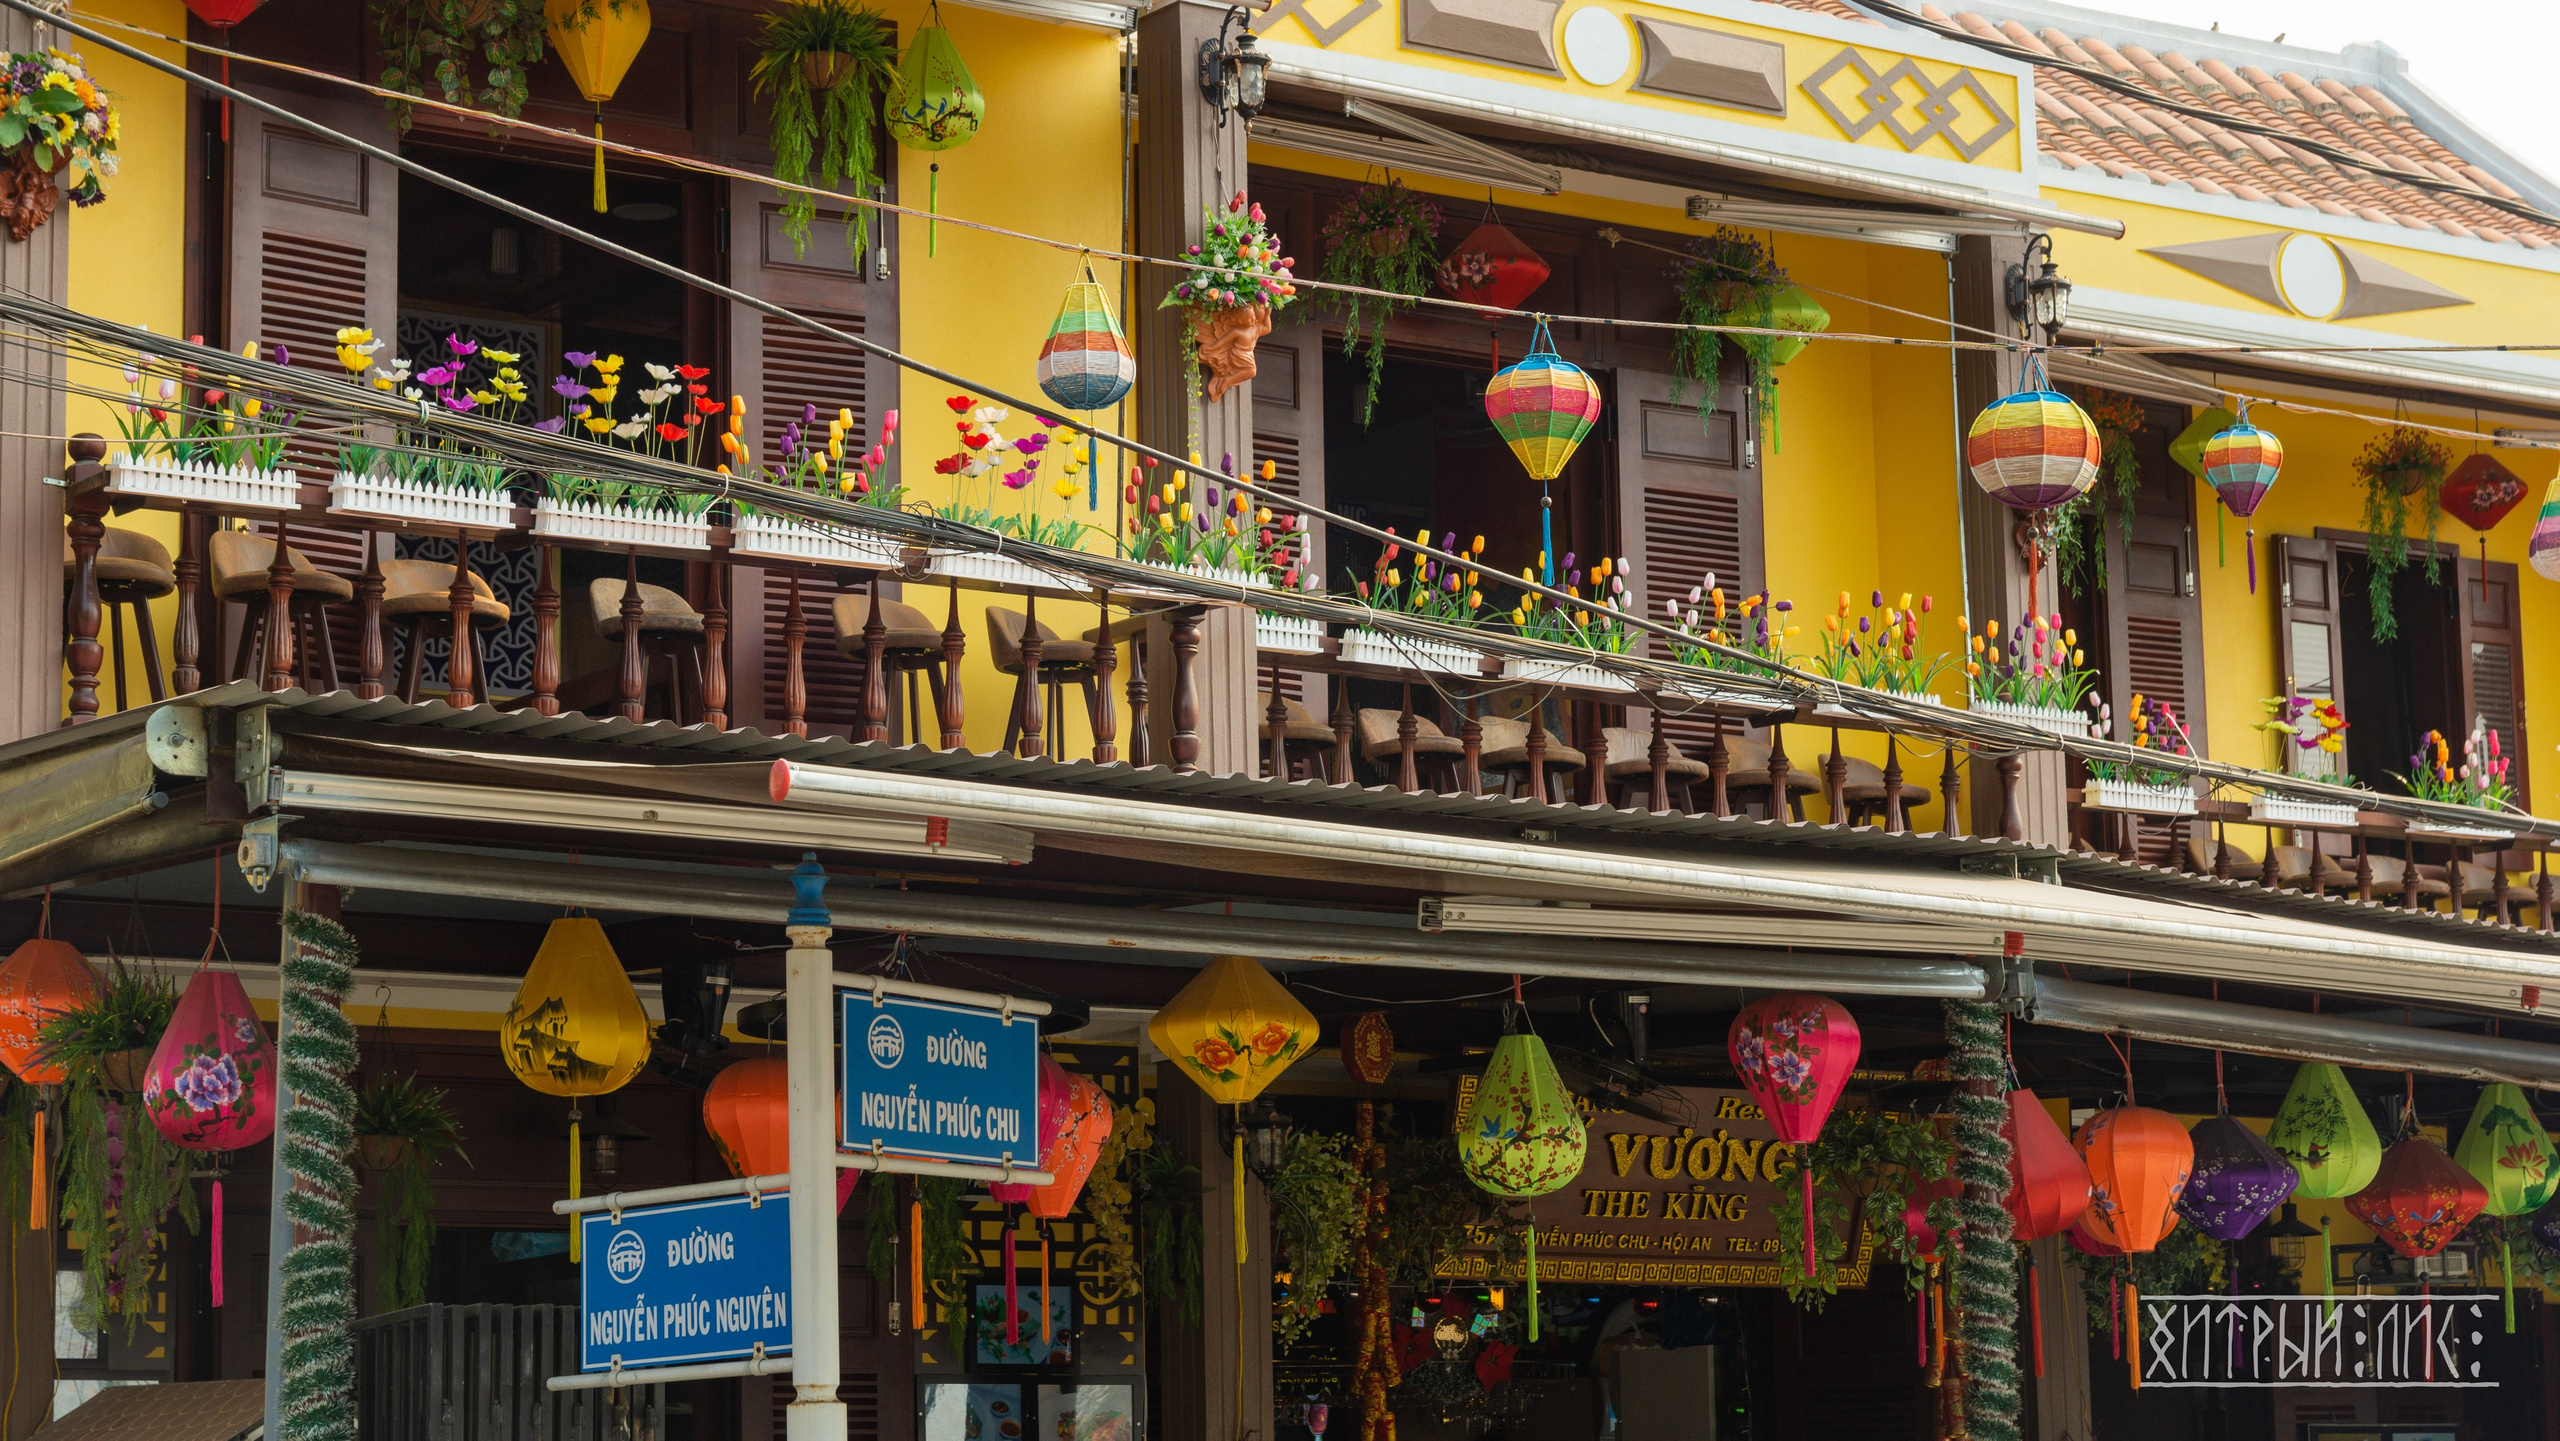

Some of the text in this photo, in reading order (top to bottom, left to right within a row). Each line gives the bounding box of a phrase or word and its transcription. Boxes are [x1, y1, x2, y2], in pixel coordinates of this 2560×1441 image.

[927, 1029, 987, 1070] ĐƯỜNG
[862, 1084, 1019, 1143] NGUYỄN PHÚC CHU
[1609, 1128, 1797, 1183] VƯƠNG
[1585, 1190, 1651, 1218] THE
[668, 1226, 734, 1268] ĐƯỜNG
[1573, 1230, 1614, 1249] PHÚC
[1618, 1234, 1650, 1250] CHU
[1662, 1233, 1687, 1255] HỘI
[1691, 1237, 1712, 1250] AN
[1728, 1238, 1759, 1253] TEL:
[590, 1286, 787, 1346] NGUYỄN PHÚC NGUYÊN
